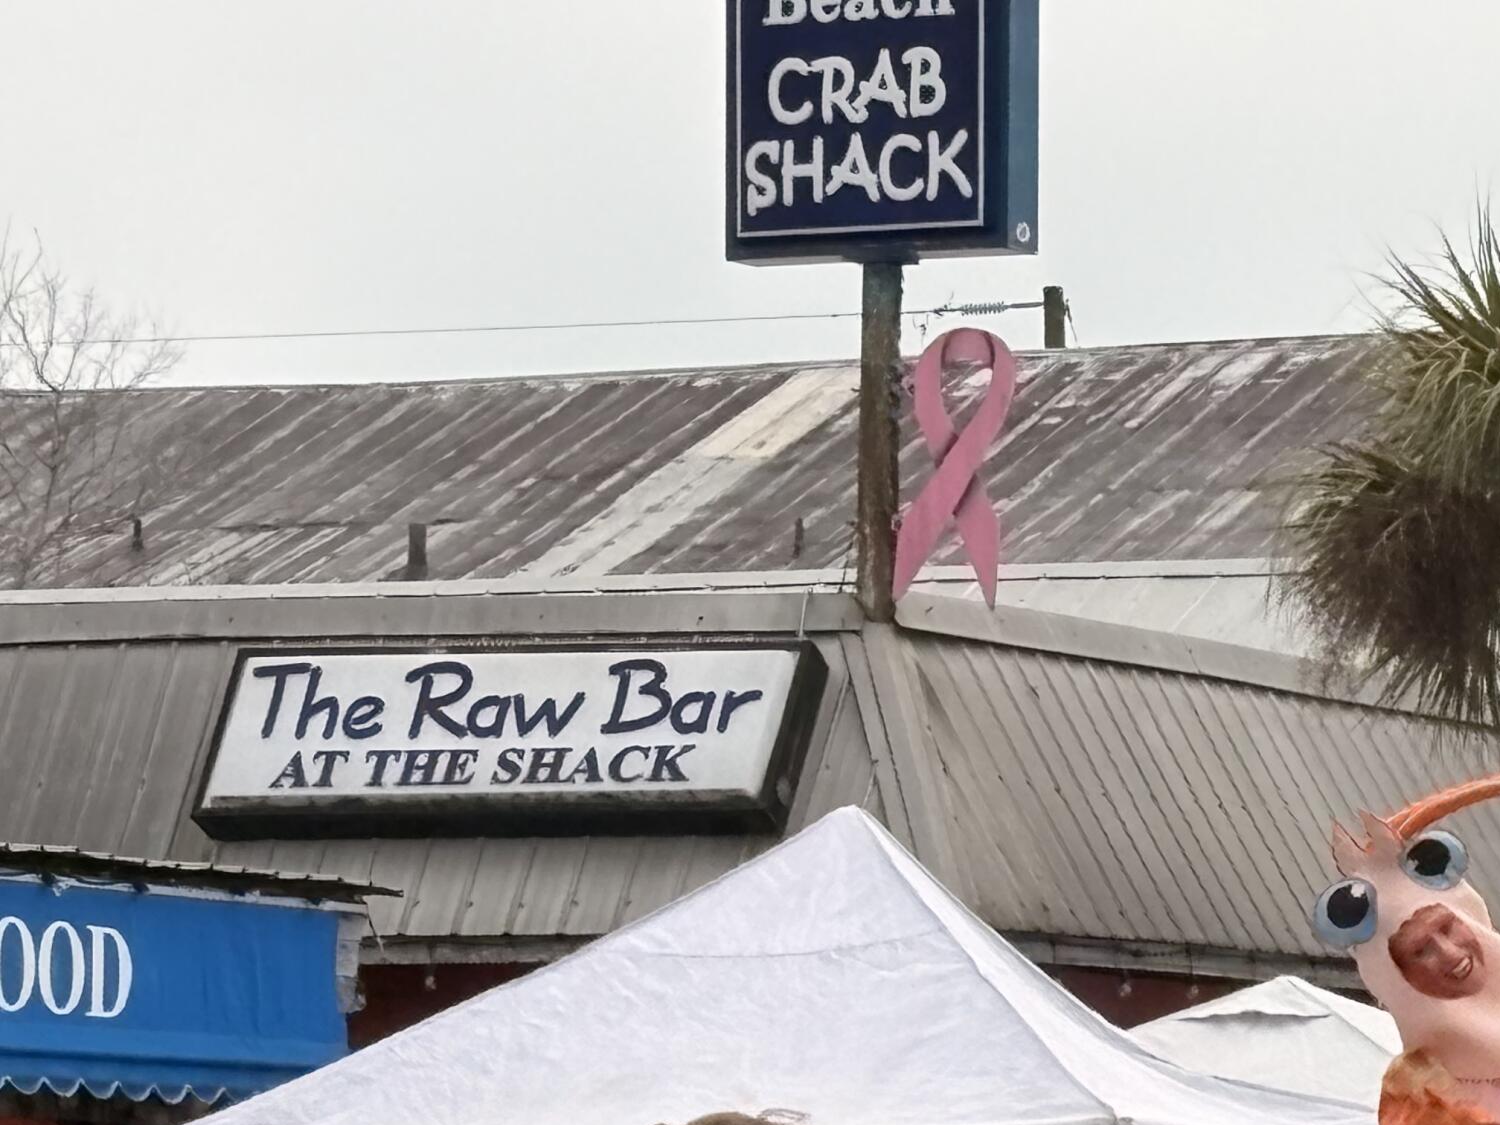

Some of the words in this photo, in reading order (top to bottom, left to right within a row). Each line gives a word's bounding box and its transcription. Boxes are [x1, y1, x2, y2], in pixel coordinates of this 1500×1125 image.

[767, 46, 947, 125] CRAB
[745, 128, 973, 216] SHACK
[253, 662, 386, 739] The
[406, 661, 587, 739] Raw
[600, 659, 764, 735] Bar
[268, 749, 350, 789] AT
[364, 749, 477, 787] THE
[491, 745, 698, 786] SHACK
[0, 915, 133, 1019] OOD
